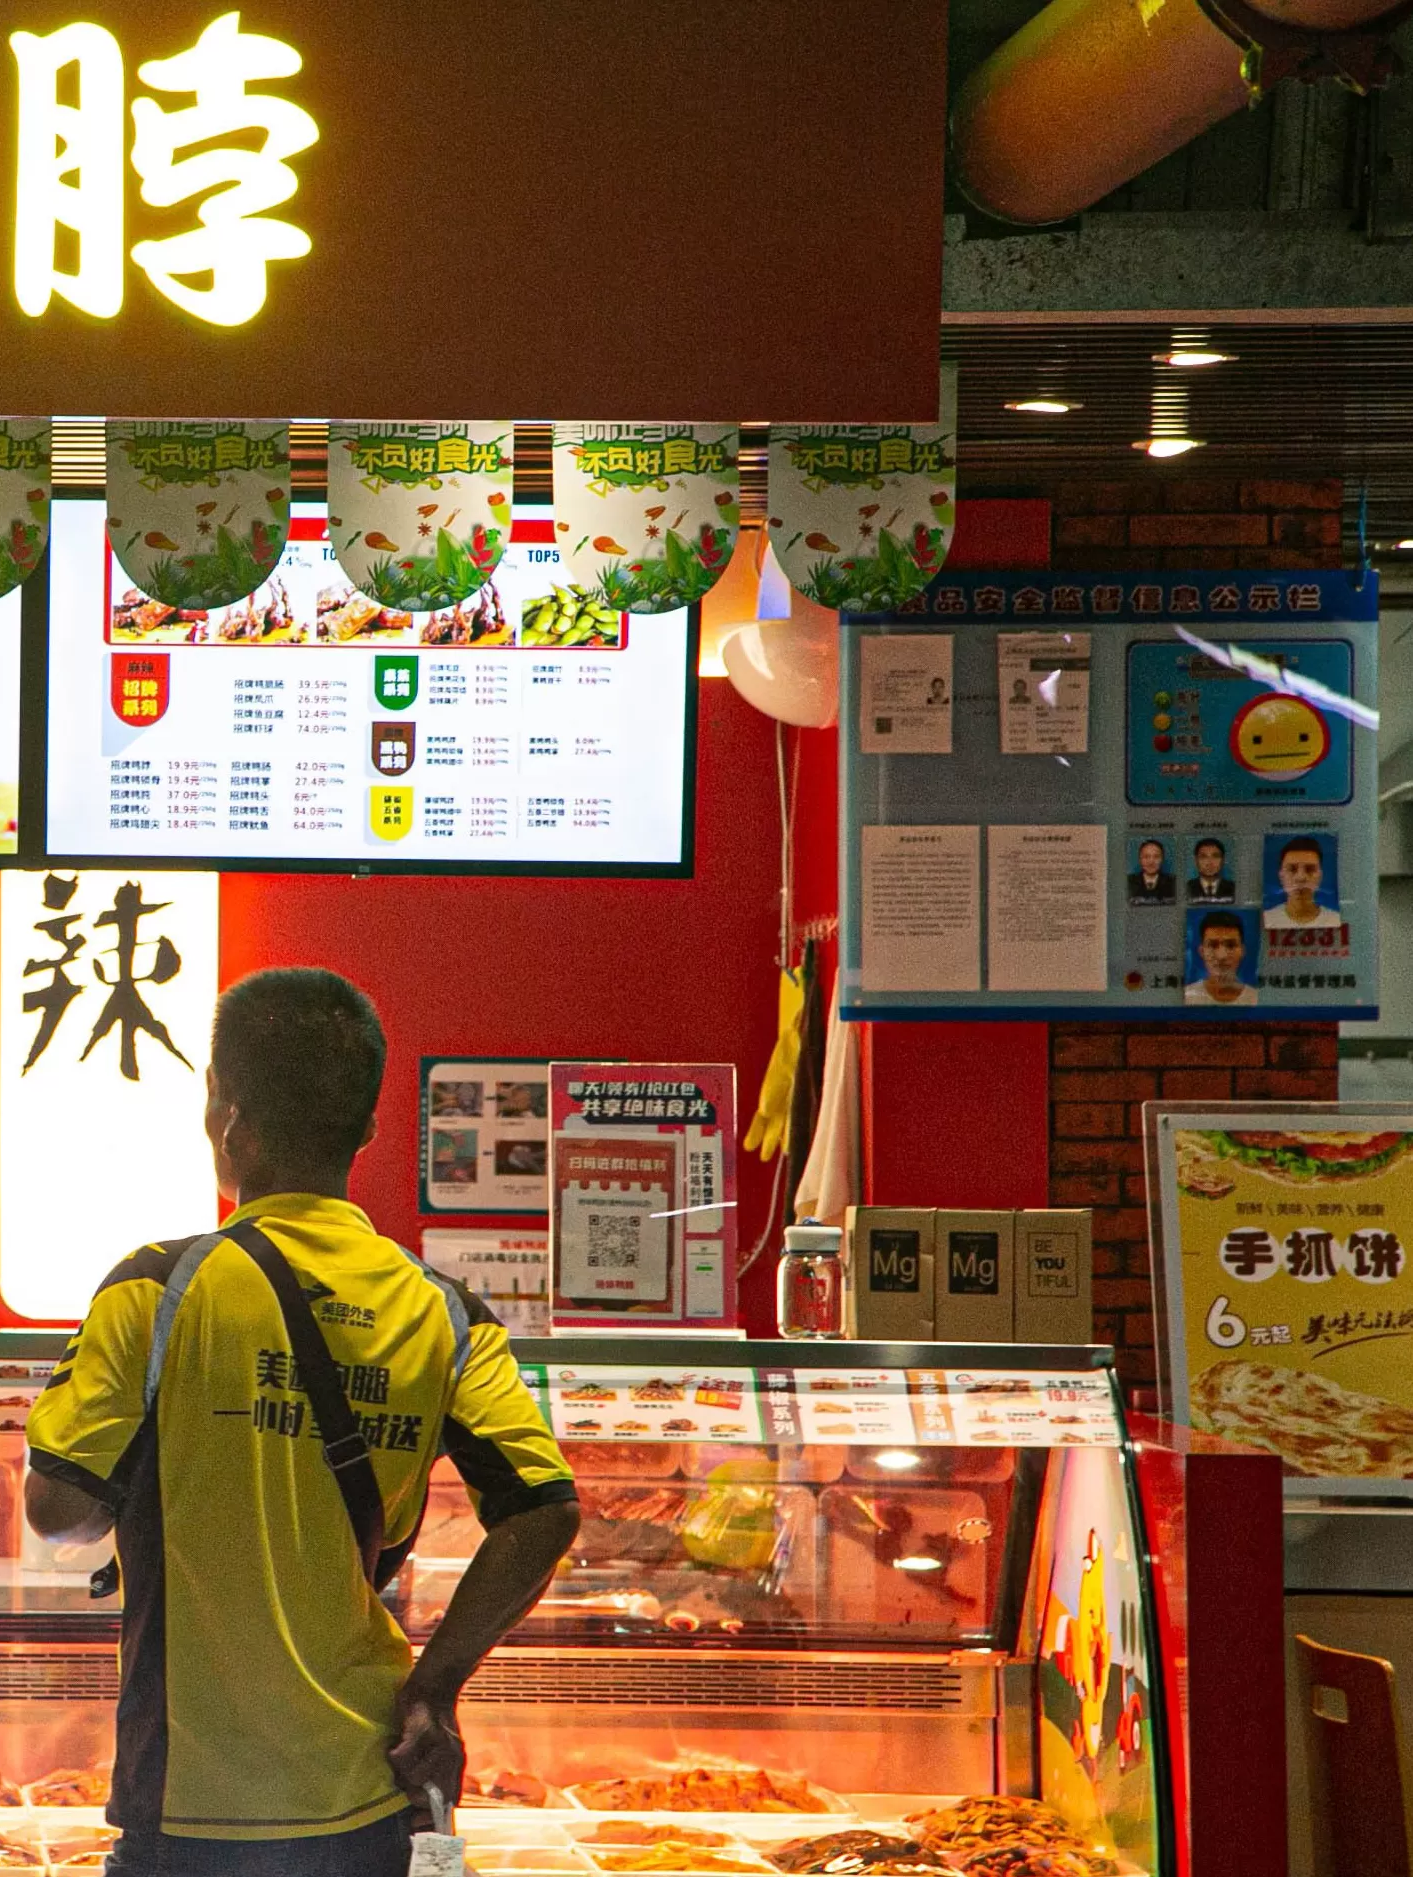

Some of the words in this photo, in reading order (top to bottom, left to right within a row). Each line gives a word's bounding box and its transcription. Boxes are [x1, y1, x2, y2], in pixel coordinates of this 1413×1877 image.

[360, 437, 497, 472] 不负好食光
[583, 439, 724, 473] 不负好食光
[528, 550, 560, 563] TOP5
[122, 680, 158, 696] 招牌
[580, 1098, 710, 1118] 共享绝味食光
[873, 1251, 916, 1283] Mg
[953, 1253, 996, 1285] Mg
[1035, 1258, 1065, 1271] YOU
[1223, 1230, 1402, 1279] 手抓饼
[212, 1396, 422, 1452] 一小时城送
